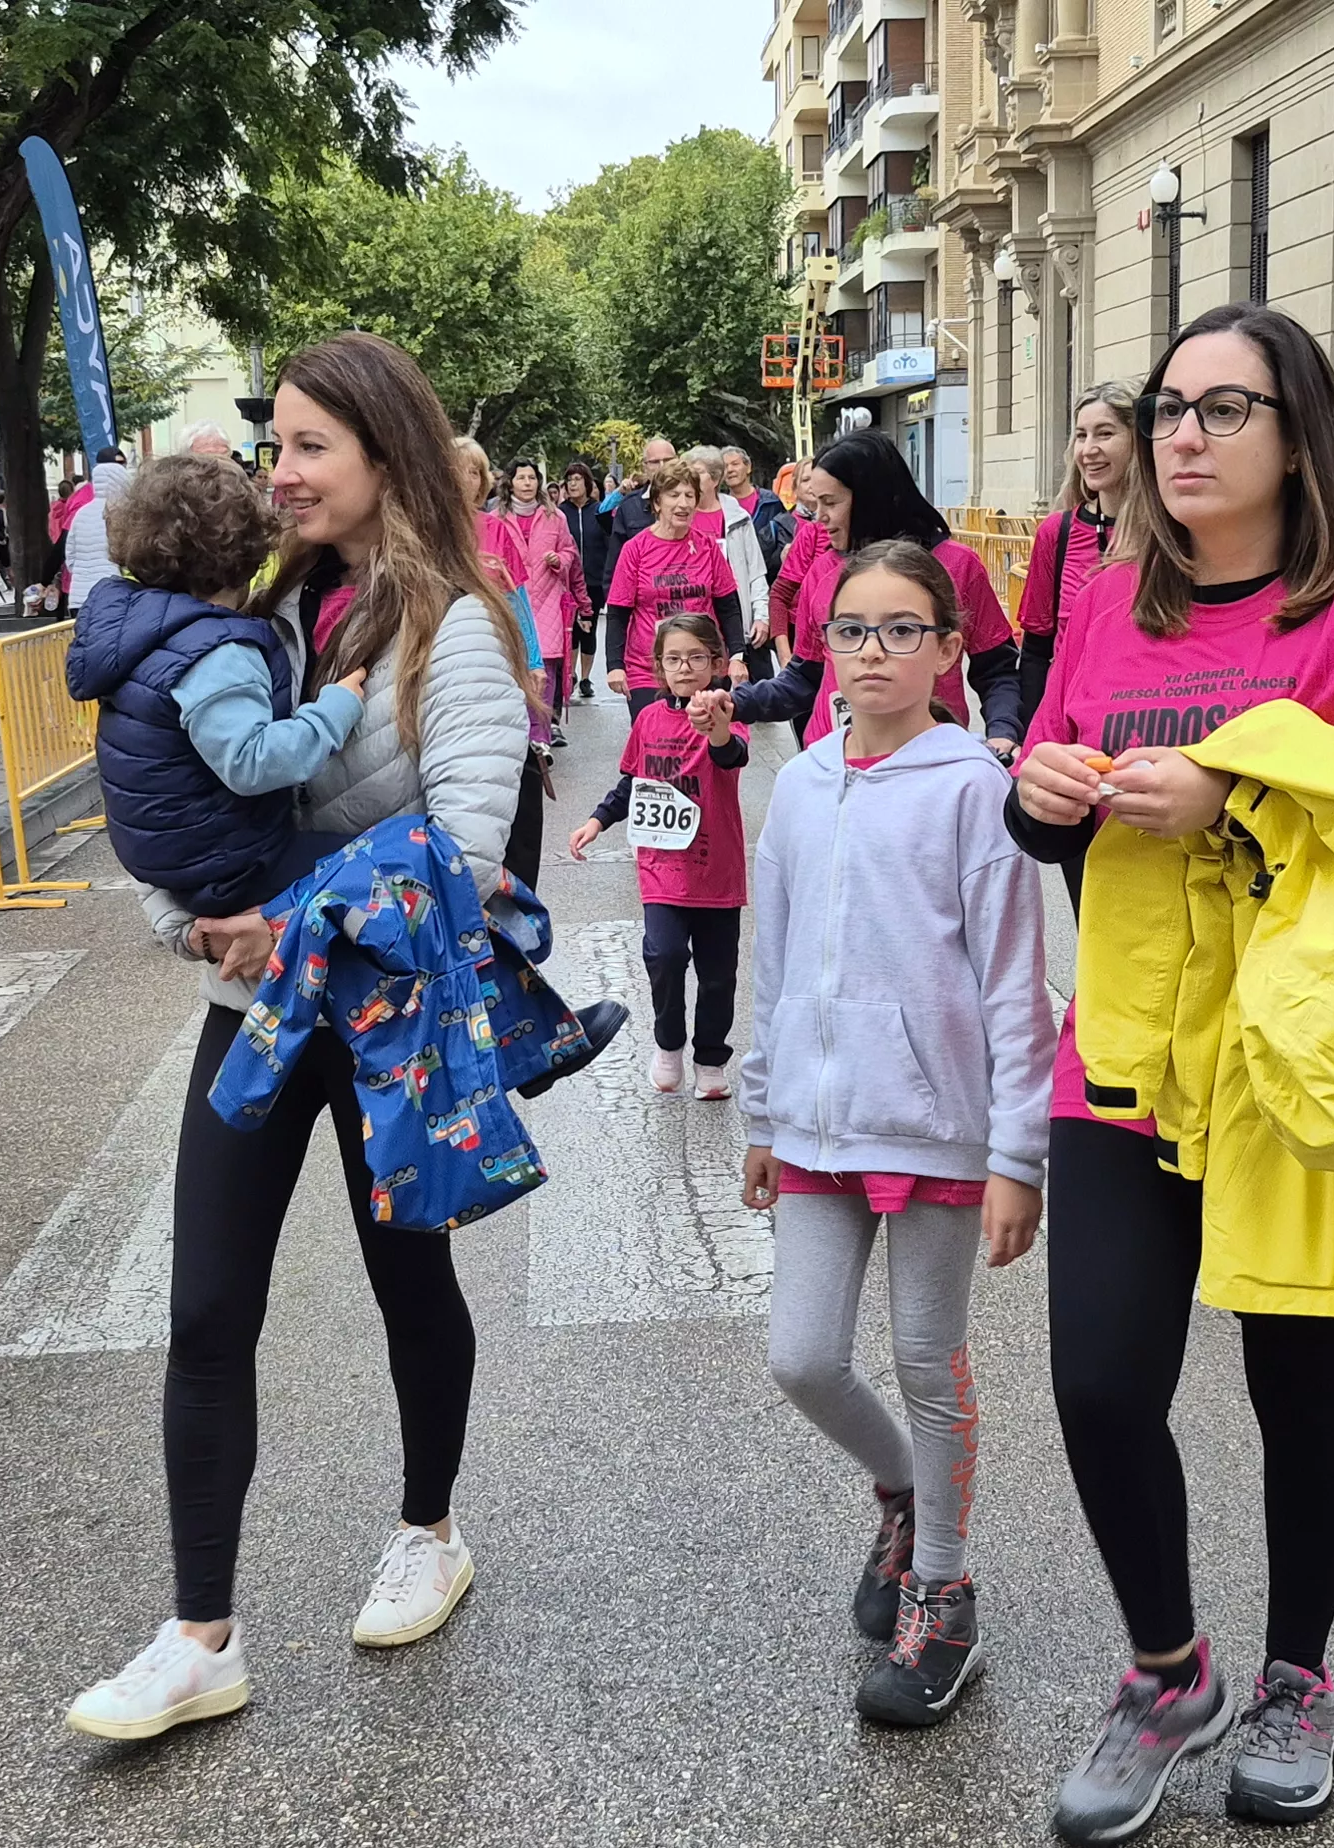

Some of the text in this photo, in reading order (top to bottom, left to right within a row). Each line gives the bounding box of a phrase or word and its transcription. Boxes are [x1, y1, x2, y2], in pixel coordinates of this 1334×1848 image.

[1110, 676, 1297, 701] HUESCA CONTRA EL CÁNCER
[1164, 667, 1245, 685] XII CARRERA
[633, 802, 692, 830] 3306
